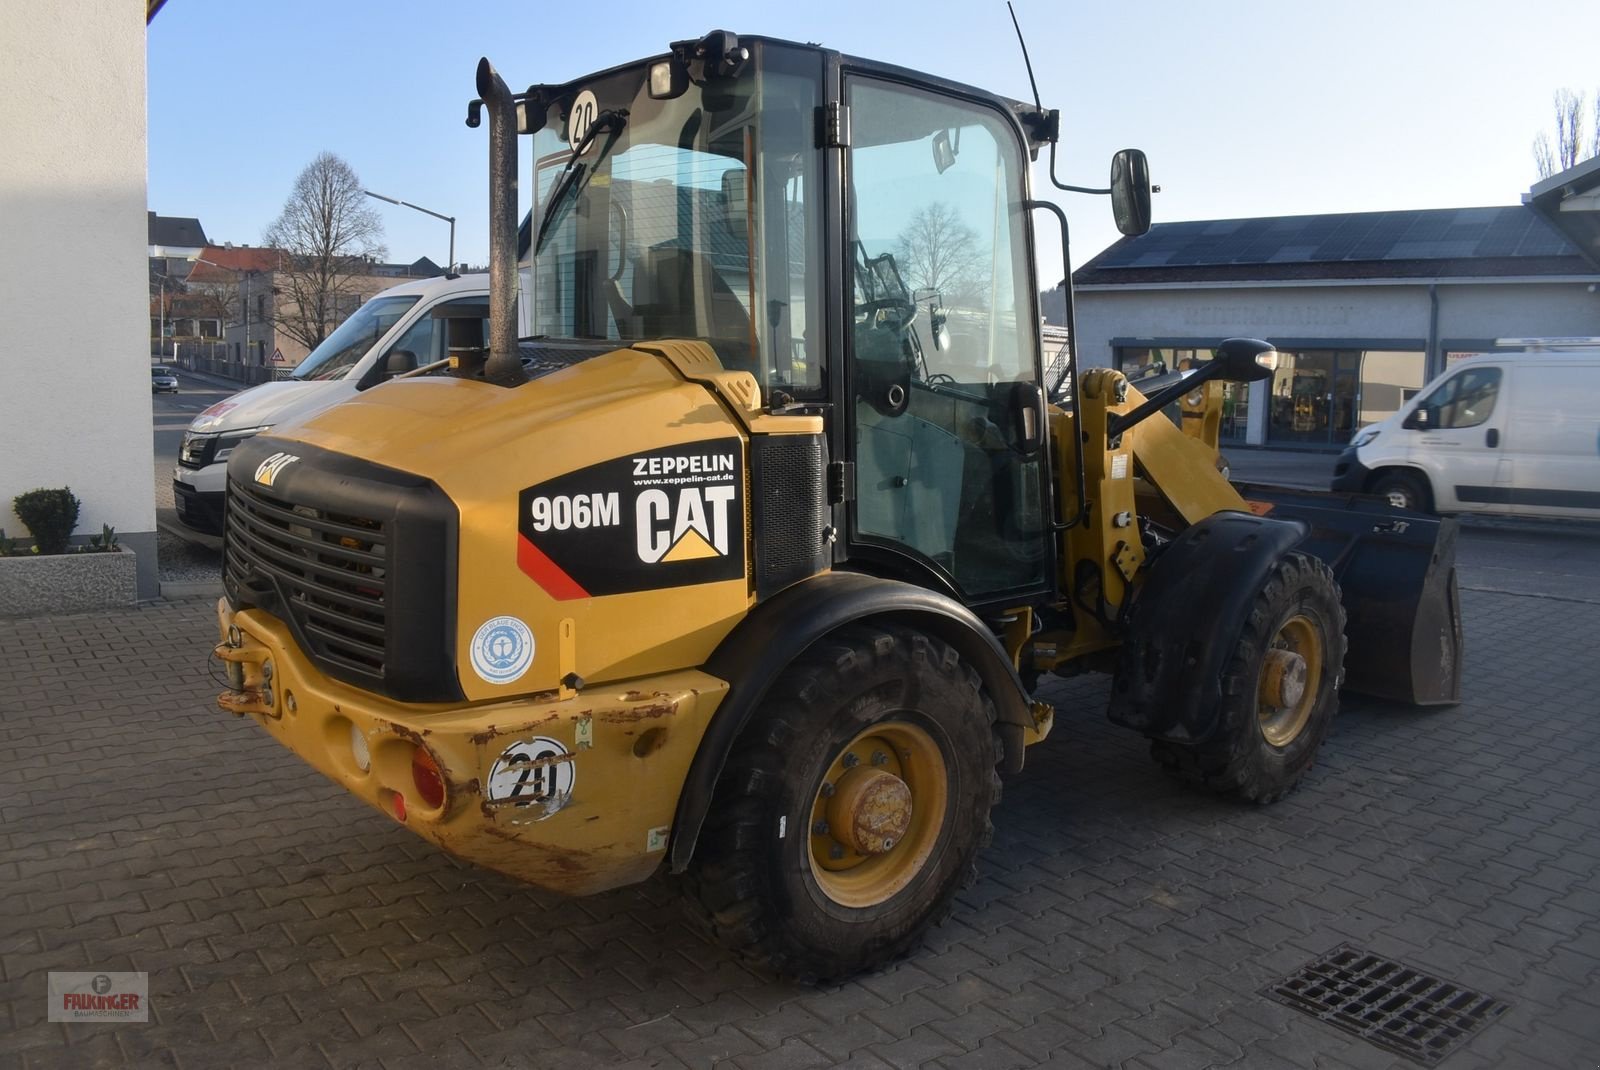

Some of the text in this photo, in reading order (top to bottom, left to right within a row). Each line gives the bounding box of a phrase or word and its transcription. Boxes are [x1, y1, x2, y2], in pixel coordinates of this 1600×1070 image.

[574, 101, 593, 144] 20
[254, 452, 301, 487] CAT
[632, 454, 734, 476] ZEPPELIN
[633, 473, 735, 486] www.zeppelin-cat.de
[531, 491, 621, 532] 906M
[635, 485, 736, 564] CAT
[508, 749, 558, 807] 20
